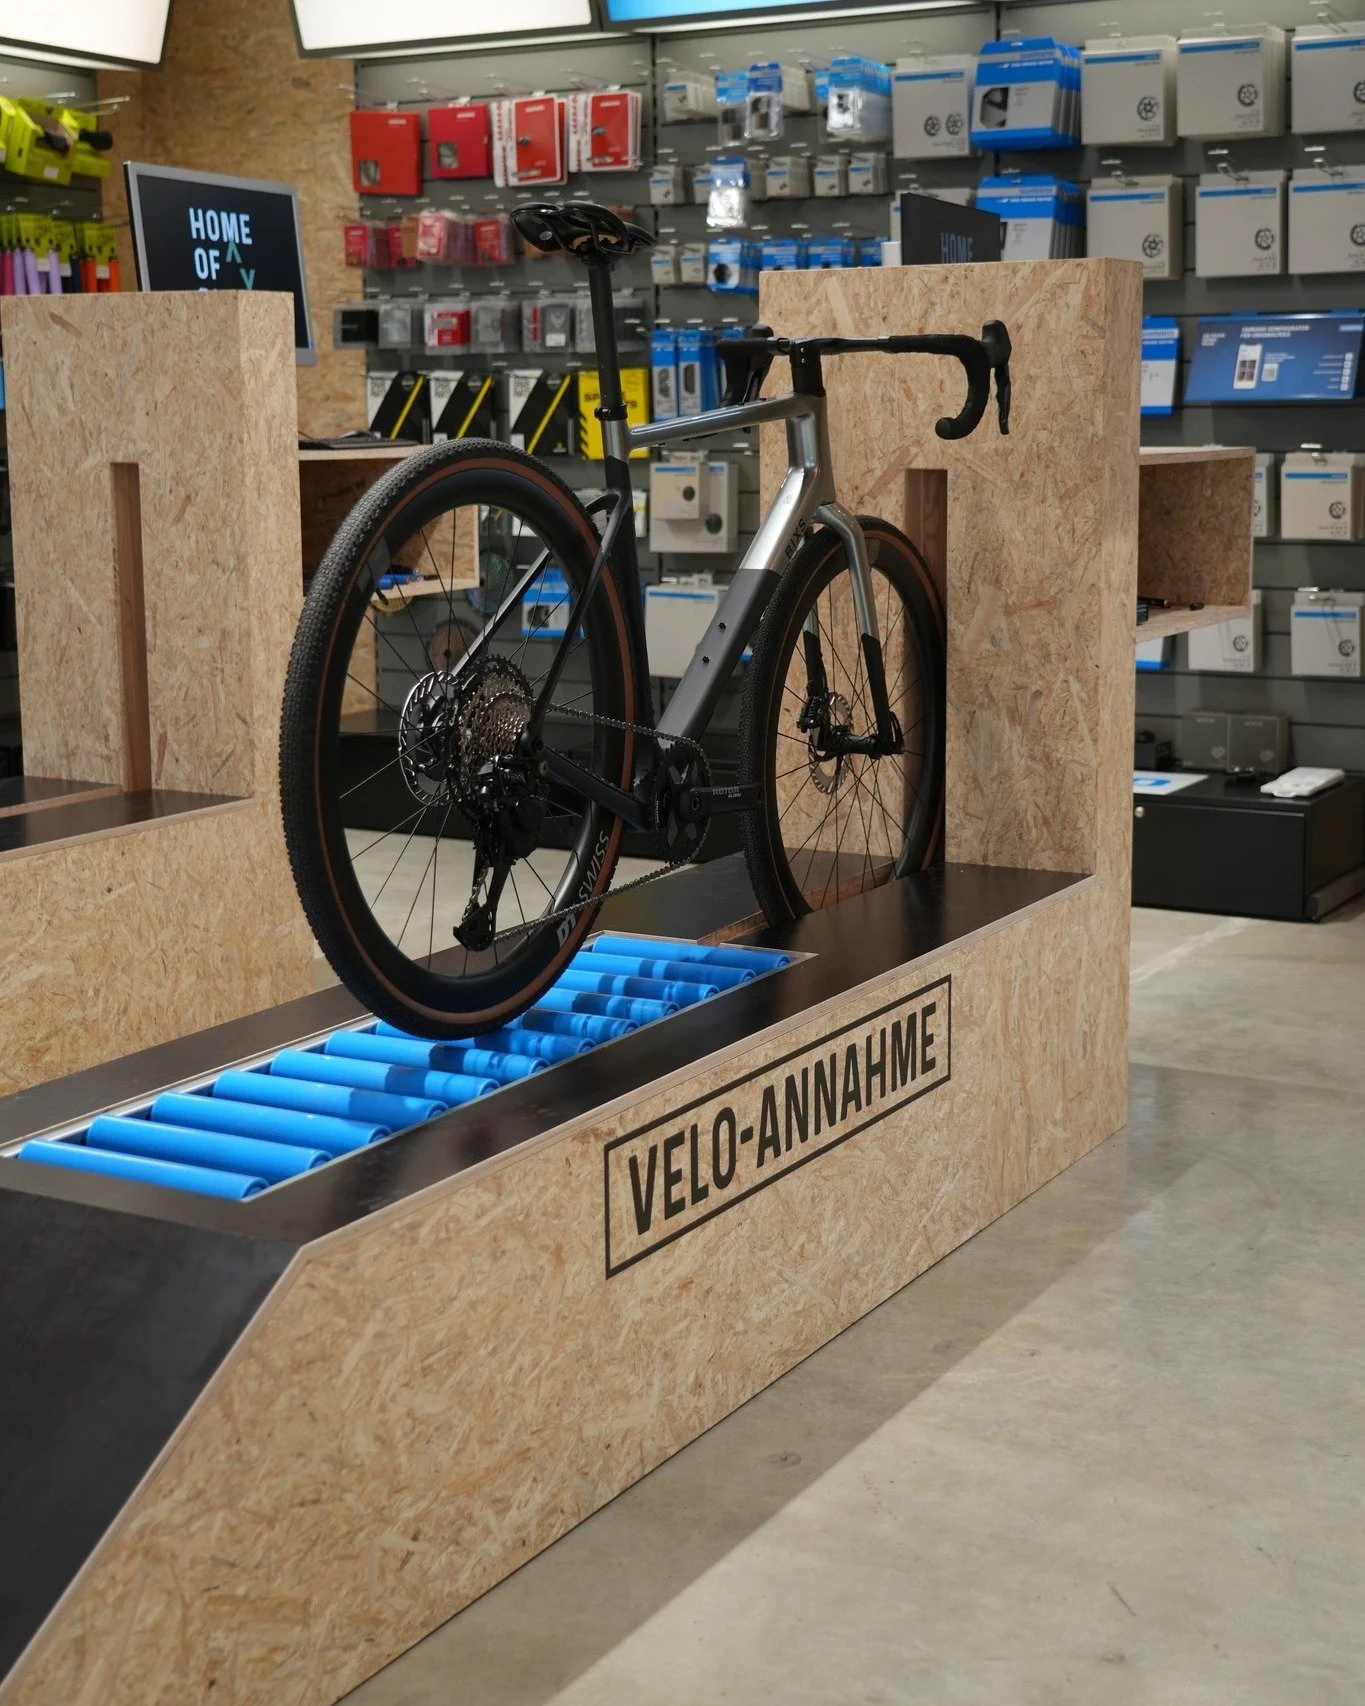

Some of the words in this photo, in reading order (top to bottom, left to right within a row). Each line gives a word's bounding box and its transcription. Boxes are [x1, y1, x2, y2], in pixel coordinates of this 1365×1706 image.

[189, 207, 253, 246] HOME
[194, 247, 221, 281] OF
[785, 518, 807, 558] BIXS
[578, 830, 610, 901] SWISS
[628, 1001, 937, 1236] VELO-ANNAHME
